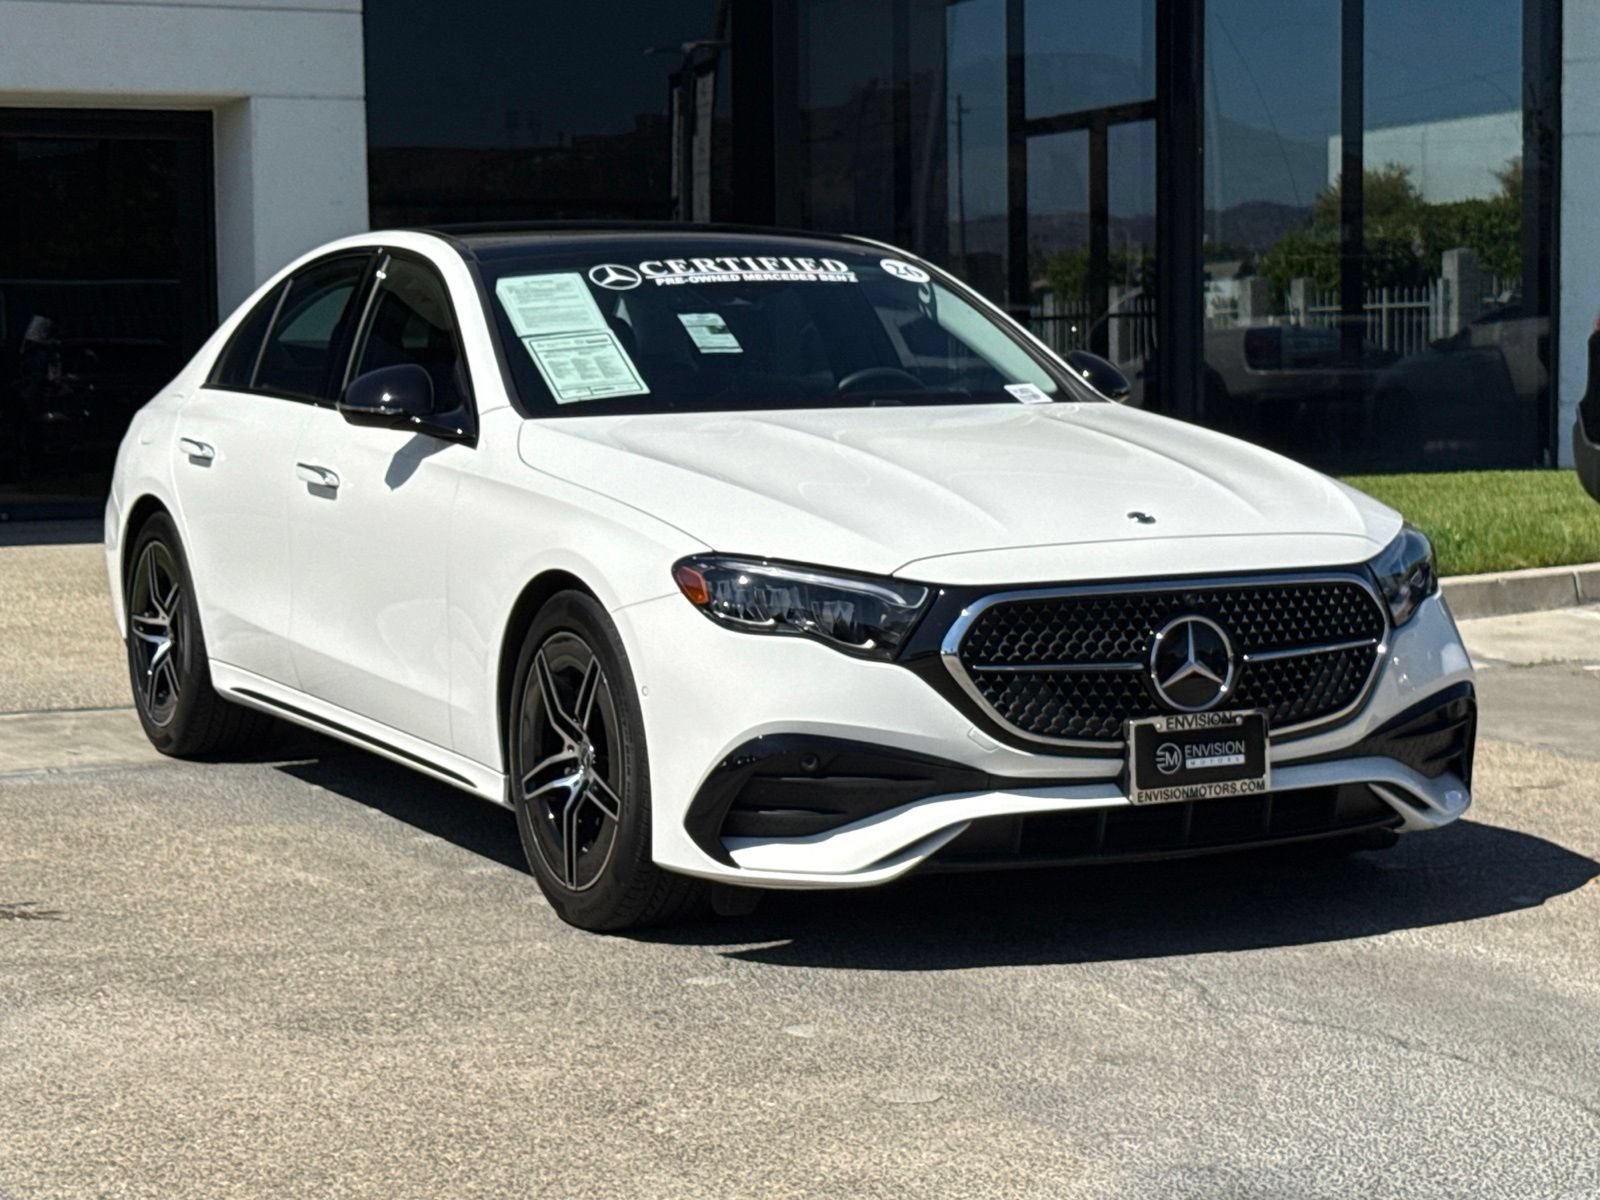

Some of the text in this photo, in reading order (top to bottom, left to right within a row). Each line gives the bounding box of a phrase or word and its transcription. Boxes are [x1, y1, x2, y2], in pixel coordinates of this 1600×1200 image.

[639, 257, 849, 276] CERTIFIED
[655, 272, 859, 286] PRE-OWNED MERCEDES BENZ
[1165, 712, 1233, 730] ENVISION
[1184, 740, 1246, 758] ENVISION
[1137, 780, 1266, 803] ENVISIONMOTORS.COM
